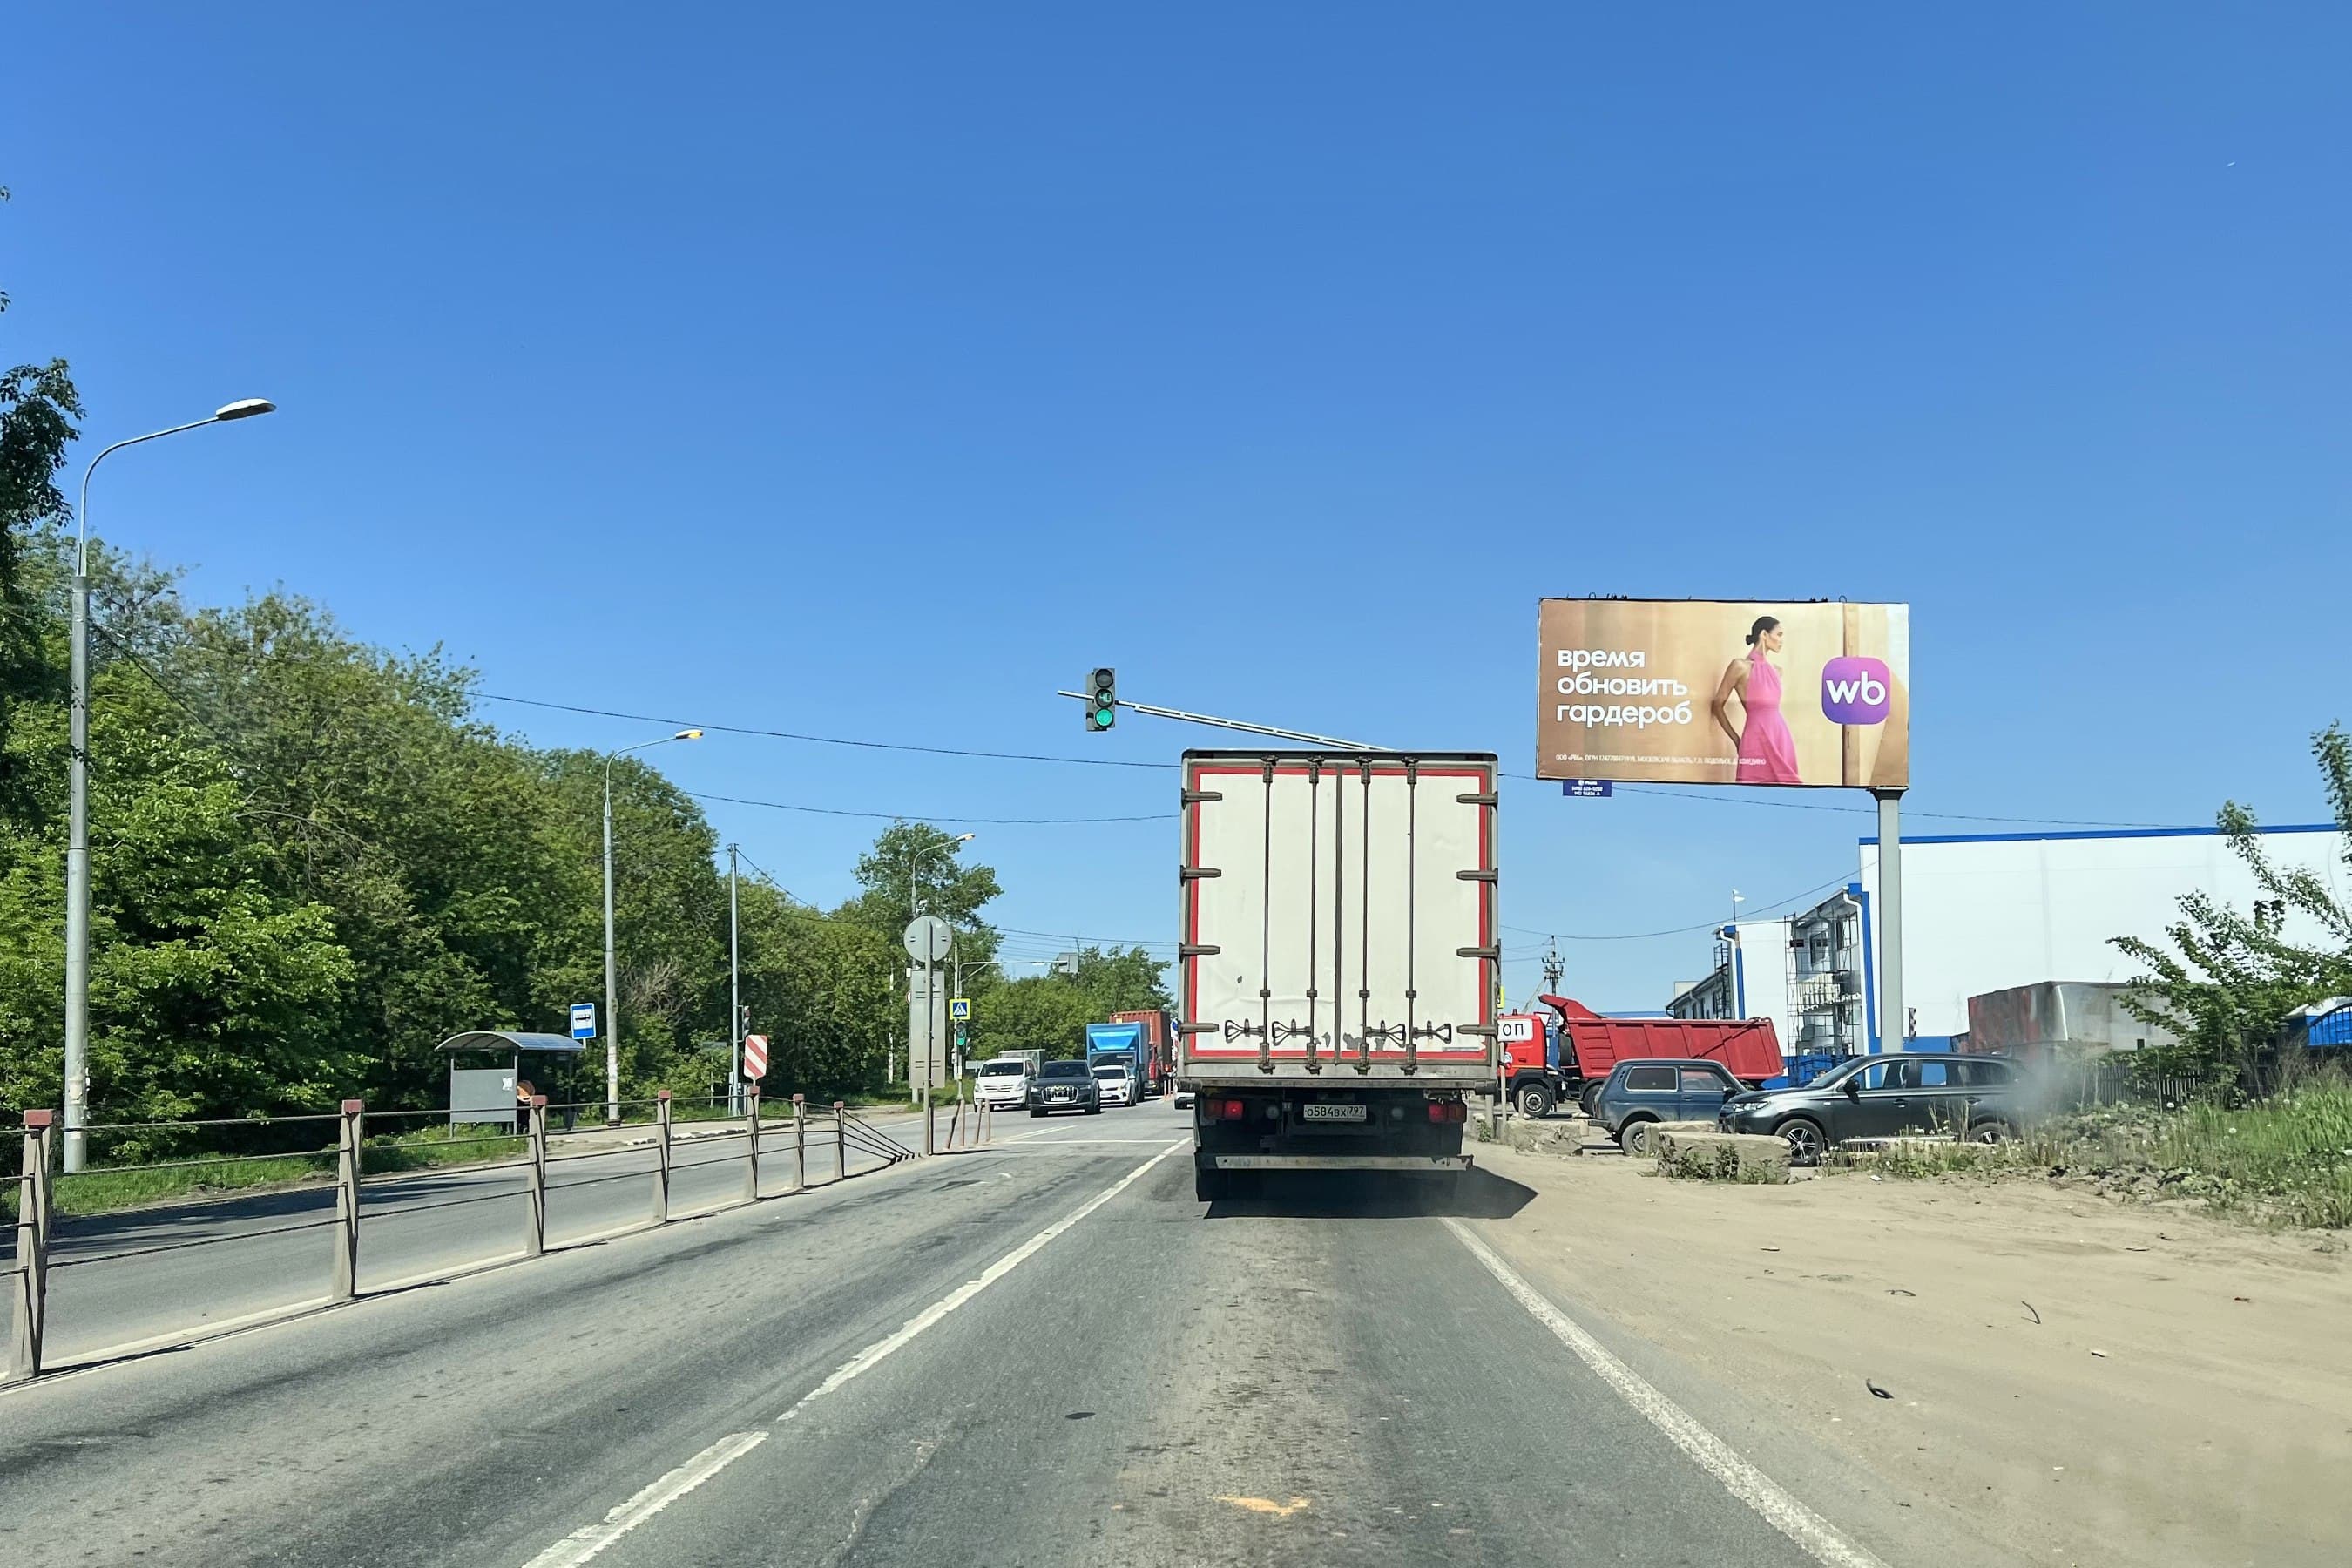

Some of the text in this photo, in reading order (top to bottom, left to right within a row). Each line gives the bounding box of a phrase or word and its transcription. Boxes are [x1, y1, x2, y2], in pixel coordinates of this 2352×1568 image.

[1557, 649, 1646, 672] время
[1557, 671, 1688, 696] обновить
[1825, 670, 1887, 706] wb
[1556, 700, 1693, 729] гардероб
[1498, 1024, 1524, 1037] ОП
